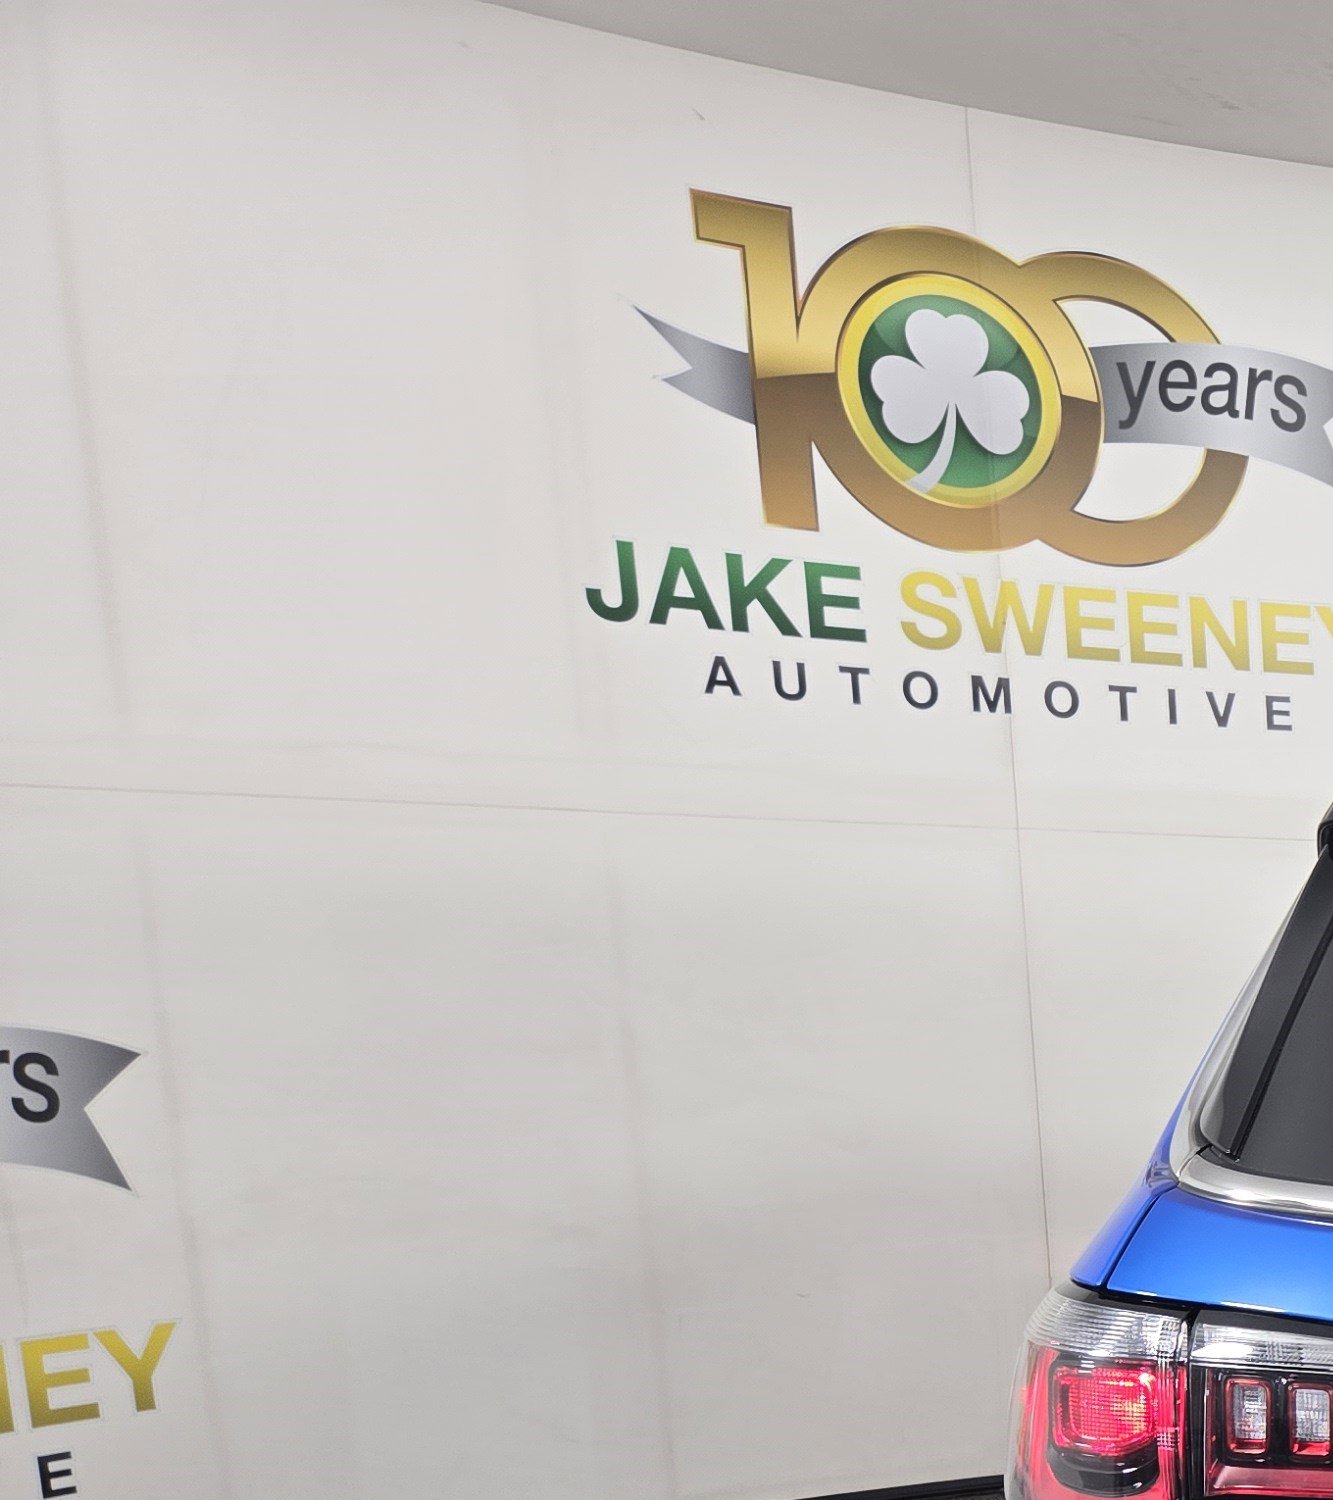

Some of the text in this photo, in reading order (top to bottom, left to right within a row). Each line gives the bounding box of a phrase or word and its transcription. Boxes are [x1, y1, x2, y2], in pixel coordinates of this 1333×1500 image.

[1116, 352, 1308, 433] years
[585, 539, 869, 642] JAKE
[704, 655, 1294, 732] AUTOMOTIVE
[0, 1050, 60, 1123] s
[0, 1322, 177, 1434] EY
